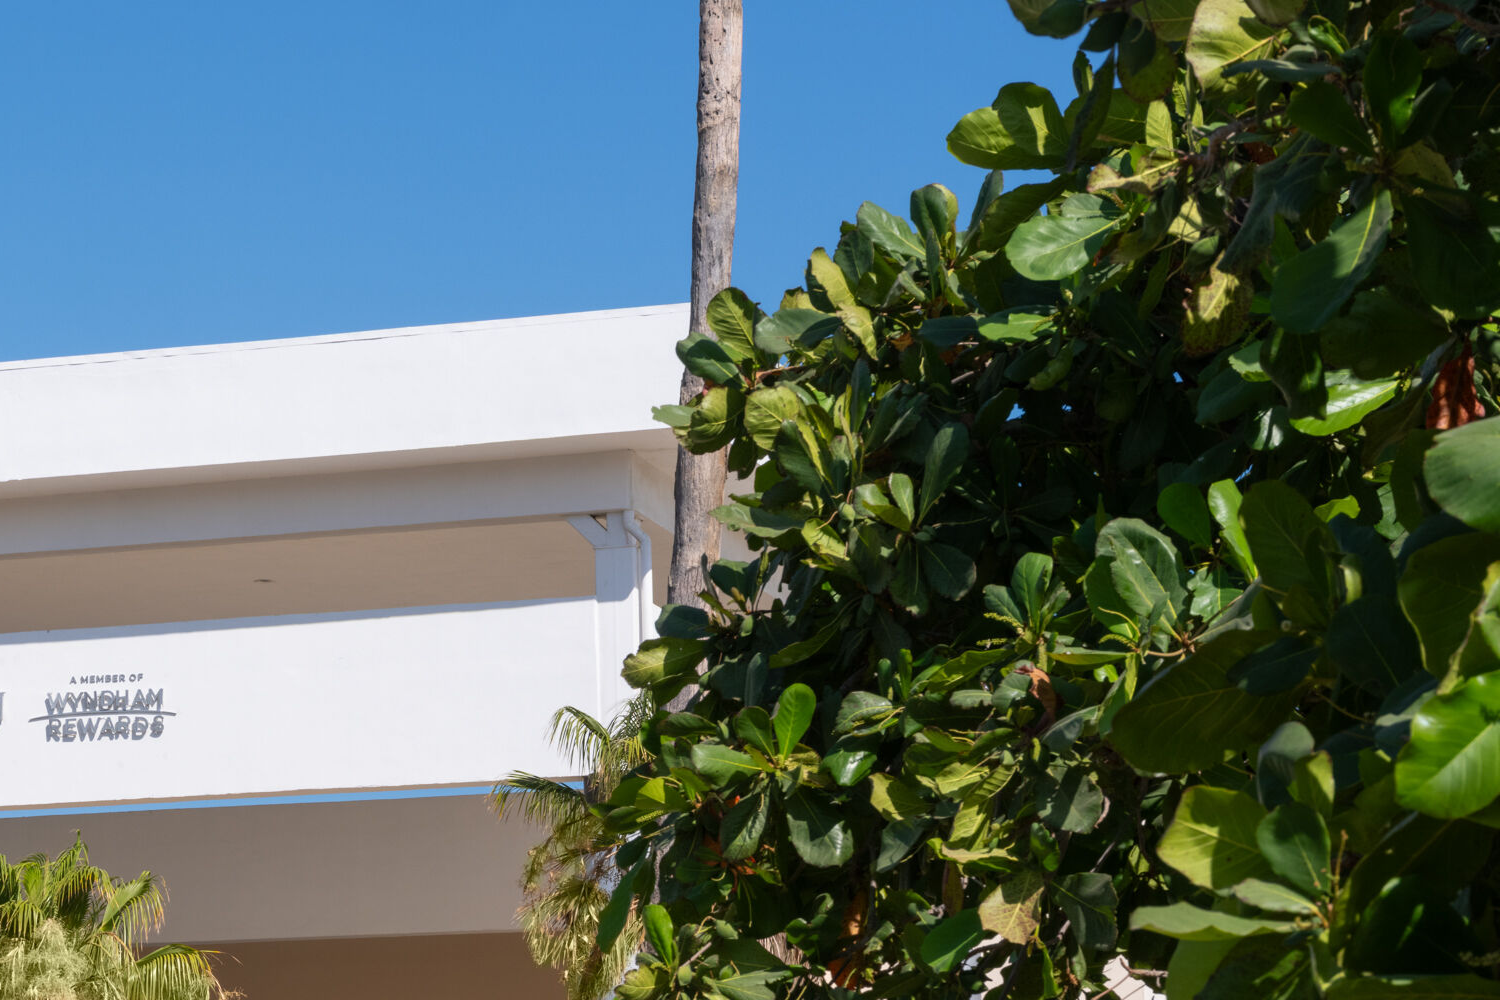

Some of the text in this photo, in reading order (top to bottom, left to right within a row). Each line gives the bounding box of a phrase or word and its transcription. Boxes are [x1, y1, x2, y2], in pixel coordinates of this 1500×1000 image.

[69, 673, 143, 685] A MEMBER OF
[45, 688, 164, 715] WYNDHAM
[45, 715, 165, 742] REWARDS
